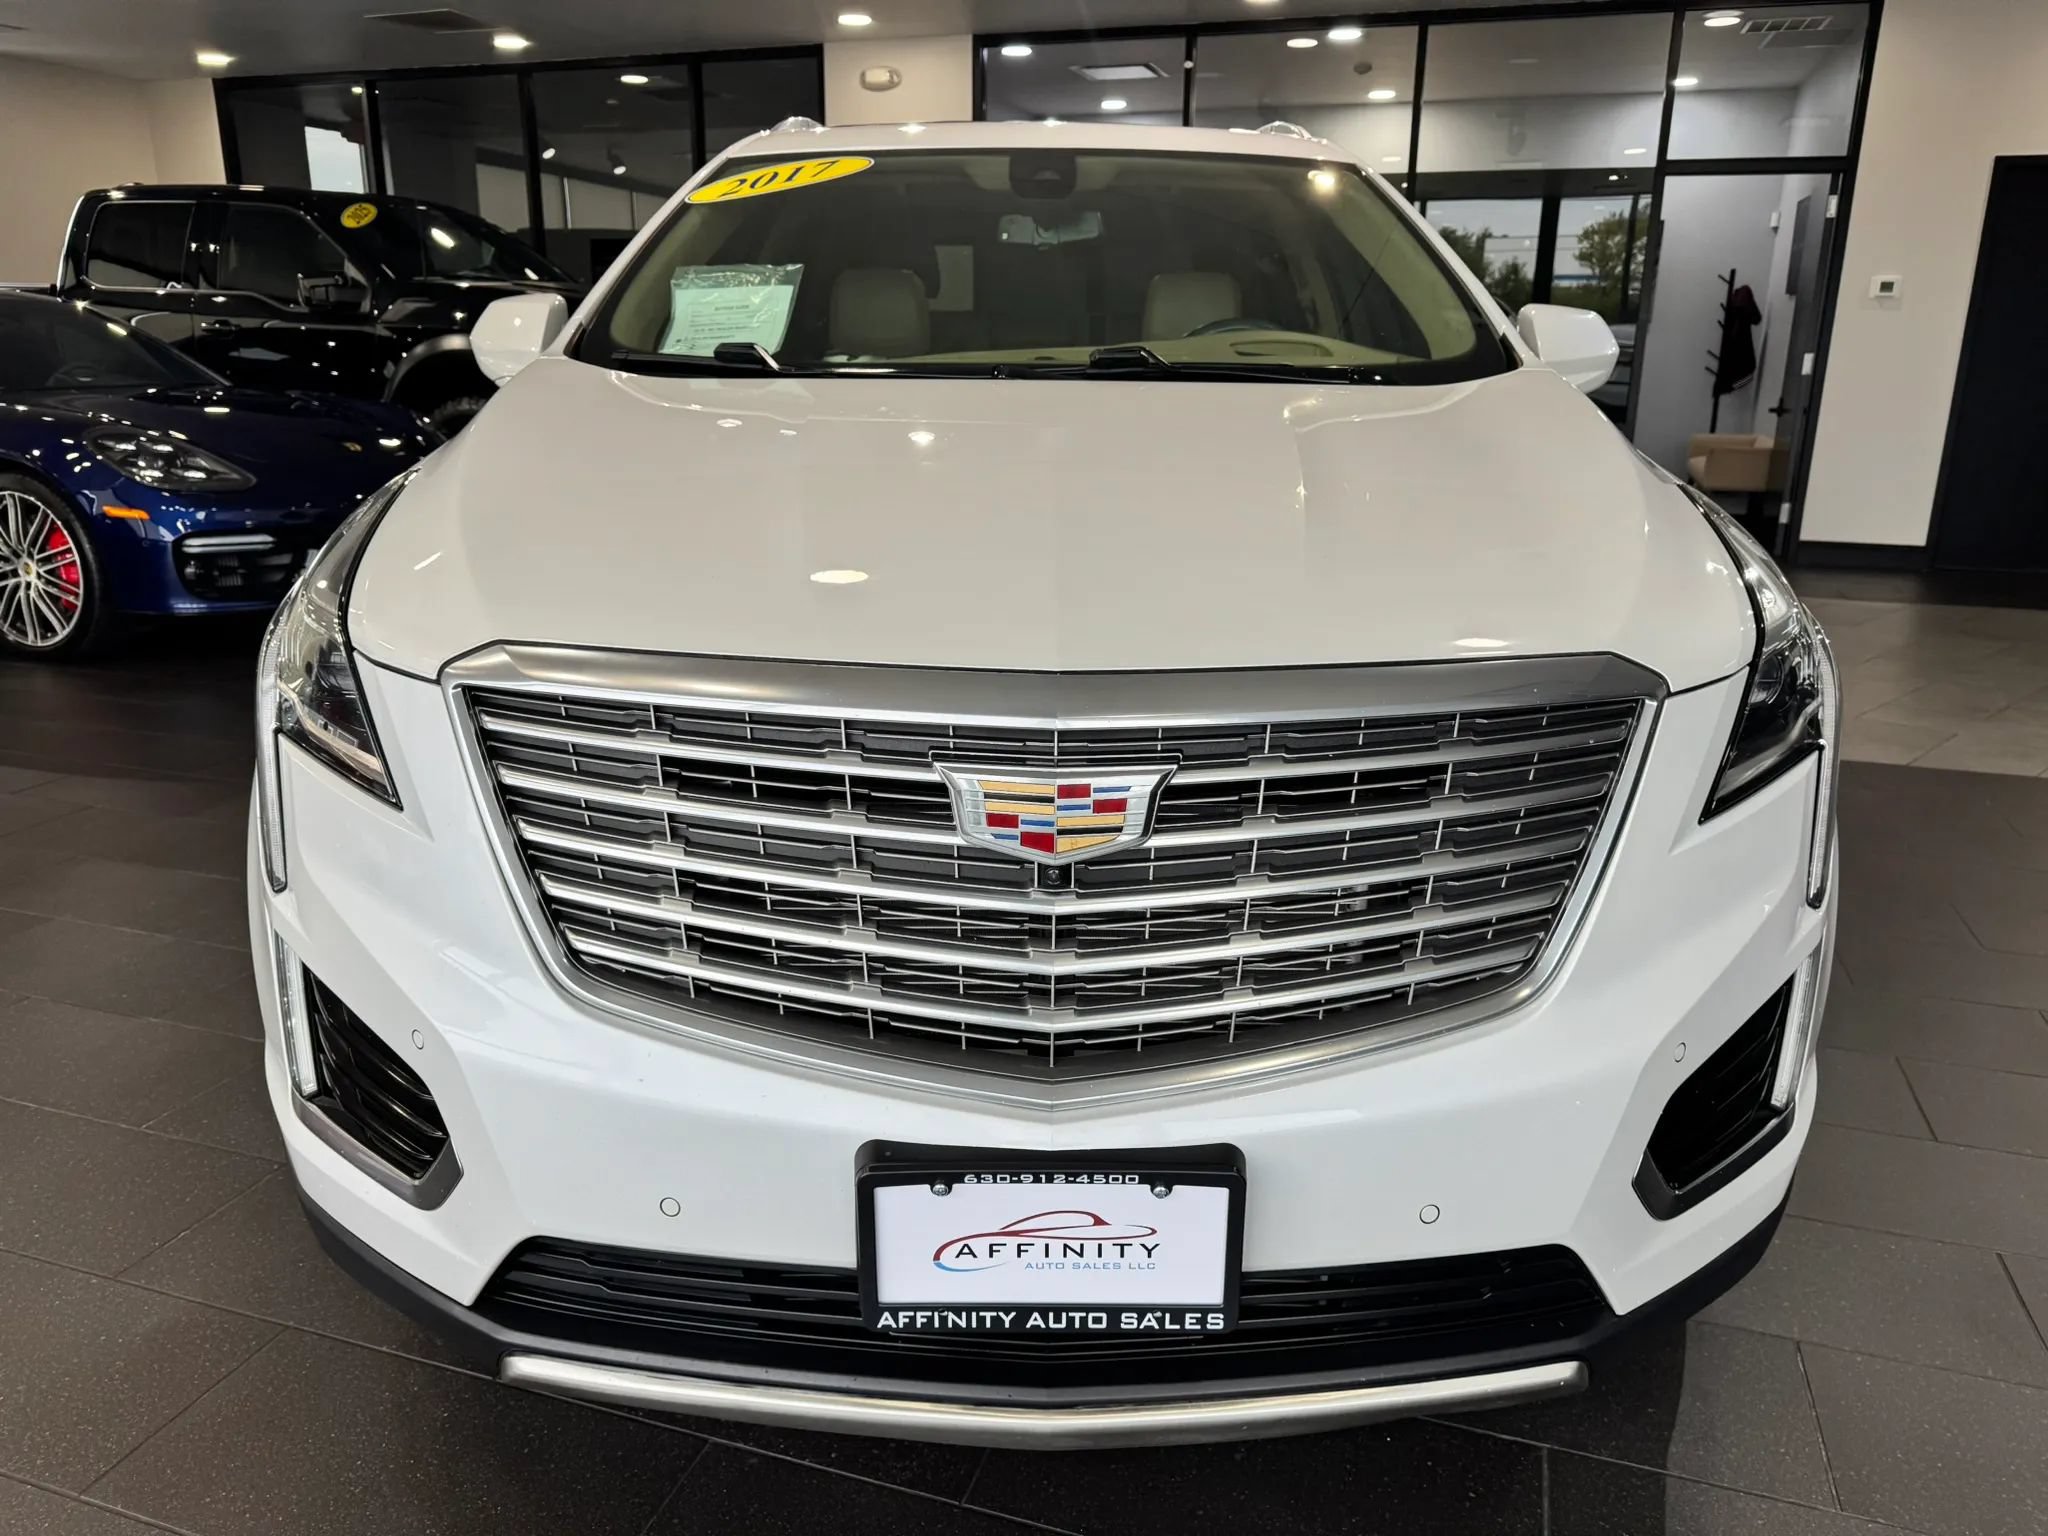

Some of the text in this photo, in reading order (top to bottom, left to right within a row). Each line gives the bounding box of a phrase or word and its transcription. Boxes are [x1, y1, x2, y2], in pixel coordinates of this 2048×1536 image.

[717, 160, 840, 199] 2017
[964, 1174, 1140, 1184] 630-912-4500
[954, 1242, 1161, 1259] AFFINITY
[1025, 1262, 1156, 1270] AUTO SALES LLC
[877, 1311, 1225, 1329] AFFINITY AUTO SALES
